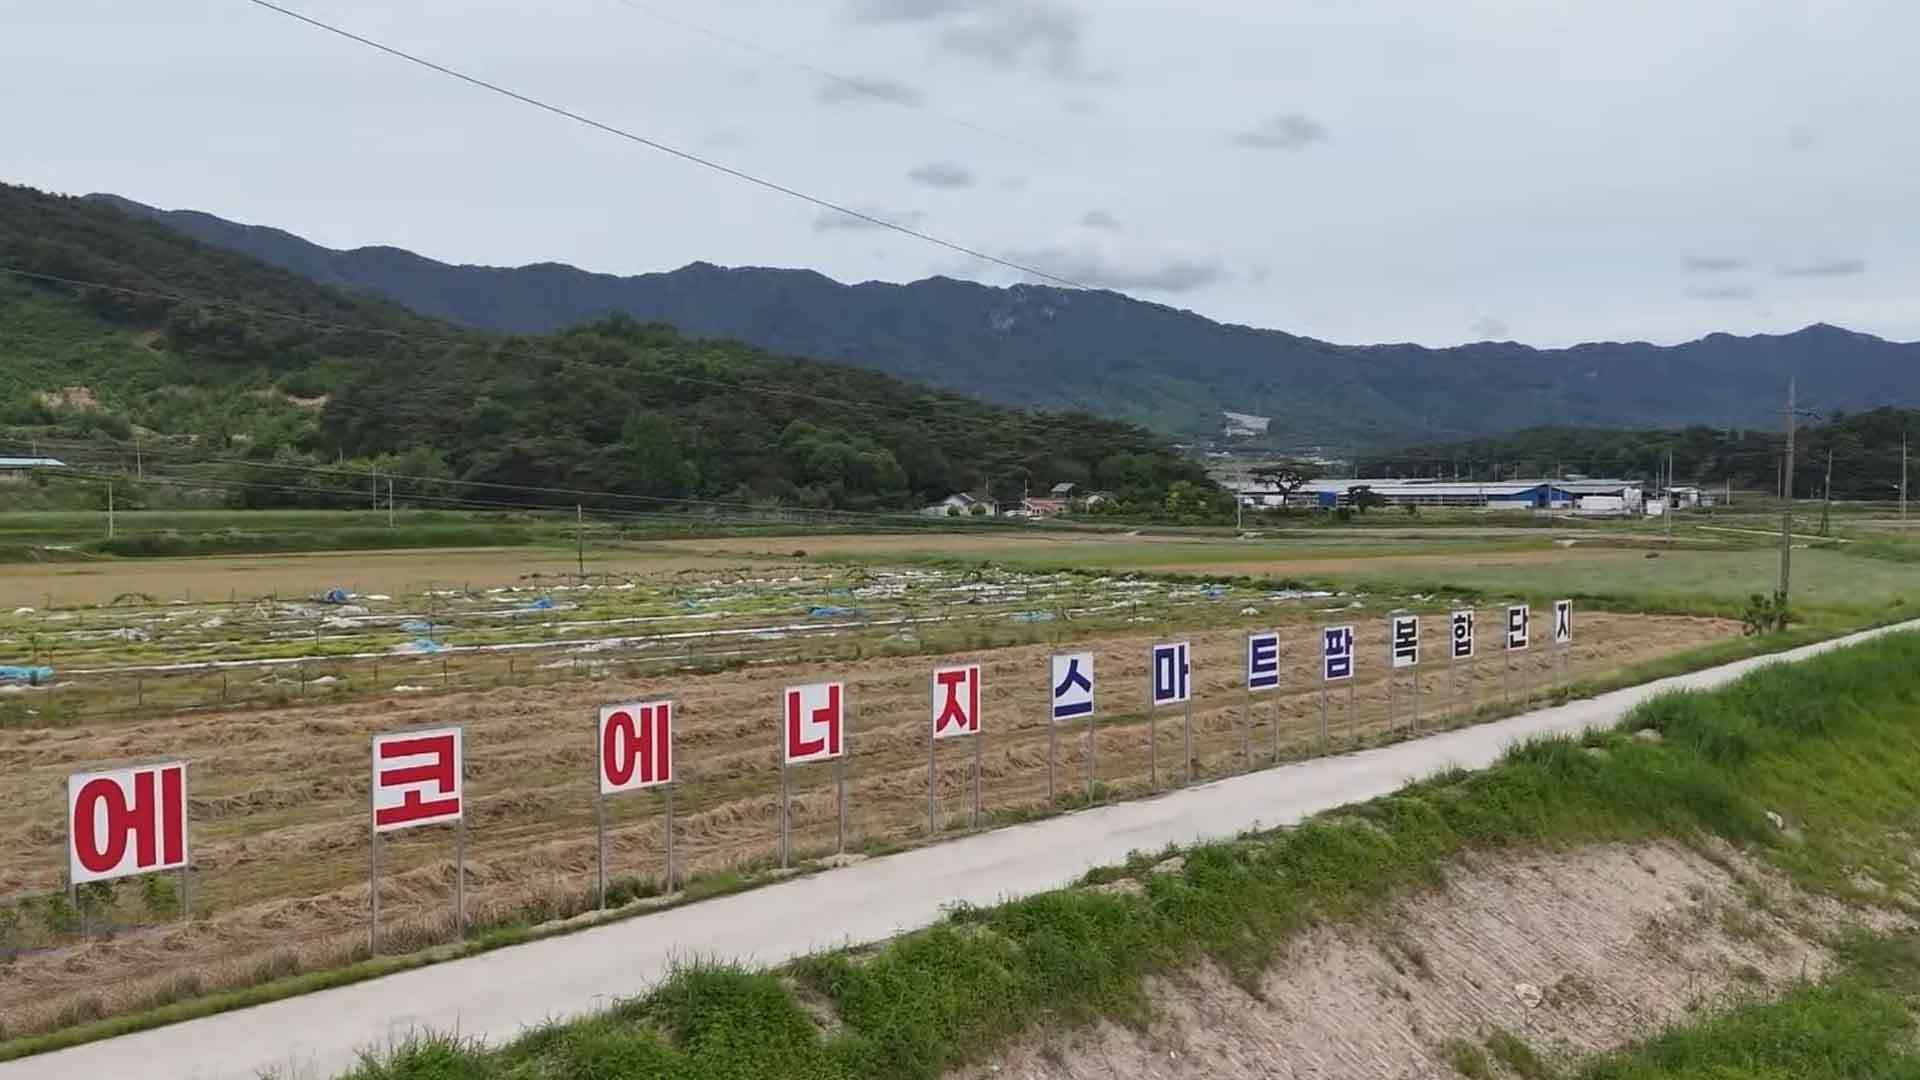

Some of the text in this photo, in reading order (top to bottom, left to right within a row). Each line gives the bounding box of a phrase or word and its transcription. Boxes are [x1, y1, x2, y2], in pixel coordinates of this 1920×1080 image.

[1395, 619, 1417, 662] 복
[1454, 614, 1473, 657] 합
[1510, 608, 1528, 649] 단
[1557, 602, 1571, 639] 지
[1156, 645, 1190, 700] 마
[1251, 638, 1278, 687] 트
[1327, 629, 1352, 678] 팜
[937, 668, 978, 731] 지
[1055, 659, 1091, 717] 스
[604, 705, 669, 785] 에
[789, 686, 840, 756] 너
[377, 736, 459, 825] 코
[75, 768, 183, 872] 에
